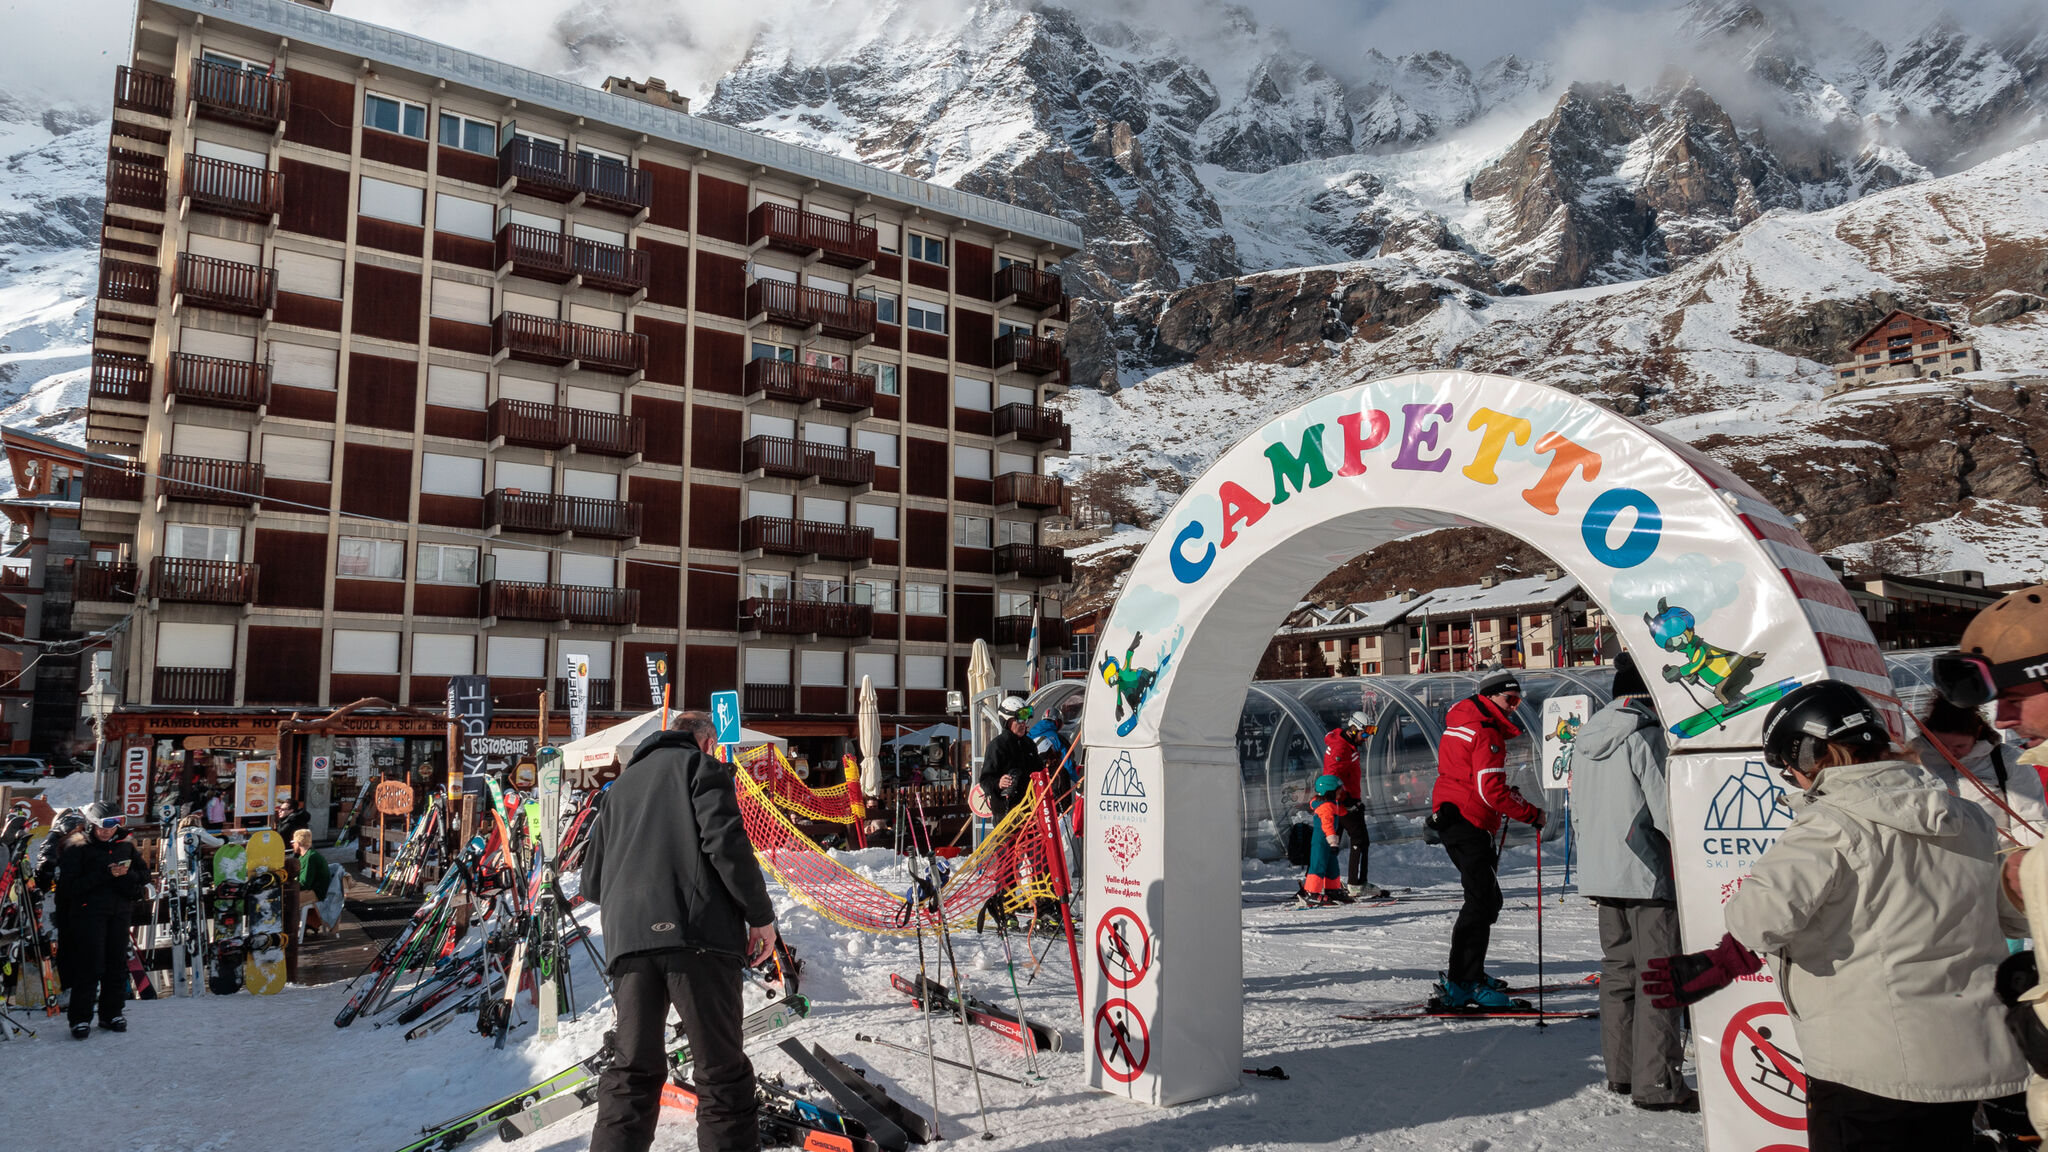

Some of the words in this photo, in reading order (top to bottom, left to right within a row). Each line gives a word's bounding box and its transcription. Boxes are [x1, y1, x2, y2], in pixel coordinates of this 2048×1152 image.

[1170, 402, 1662, 583] CAMPETTO
[150, 718, 240, 729] HAMBURGER
[399, 719, 413, 730] SCI
[471, 737, 529, 755] RISTORANTE
[378, 757, 394, 766] SCI
[126, 750, 146, 815] nutella
[1099, 800, 1148, 814] CERVINO
[1113, 815, 1147, 823] PARADISE
[1703, 838, 1776, 855] CERV
[1706, 860, 1729, 868] SKI
[1105, 874, 1121, 884] Valle
